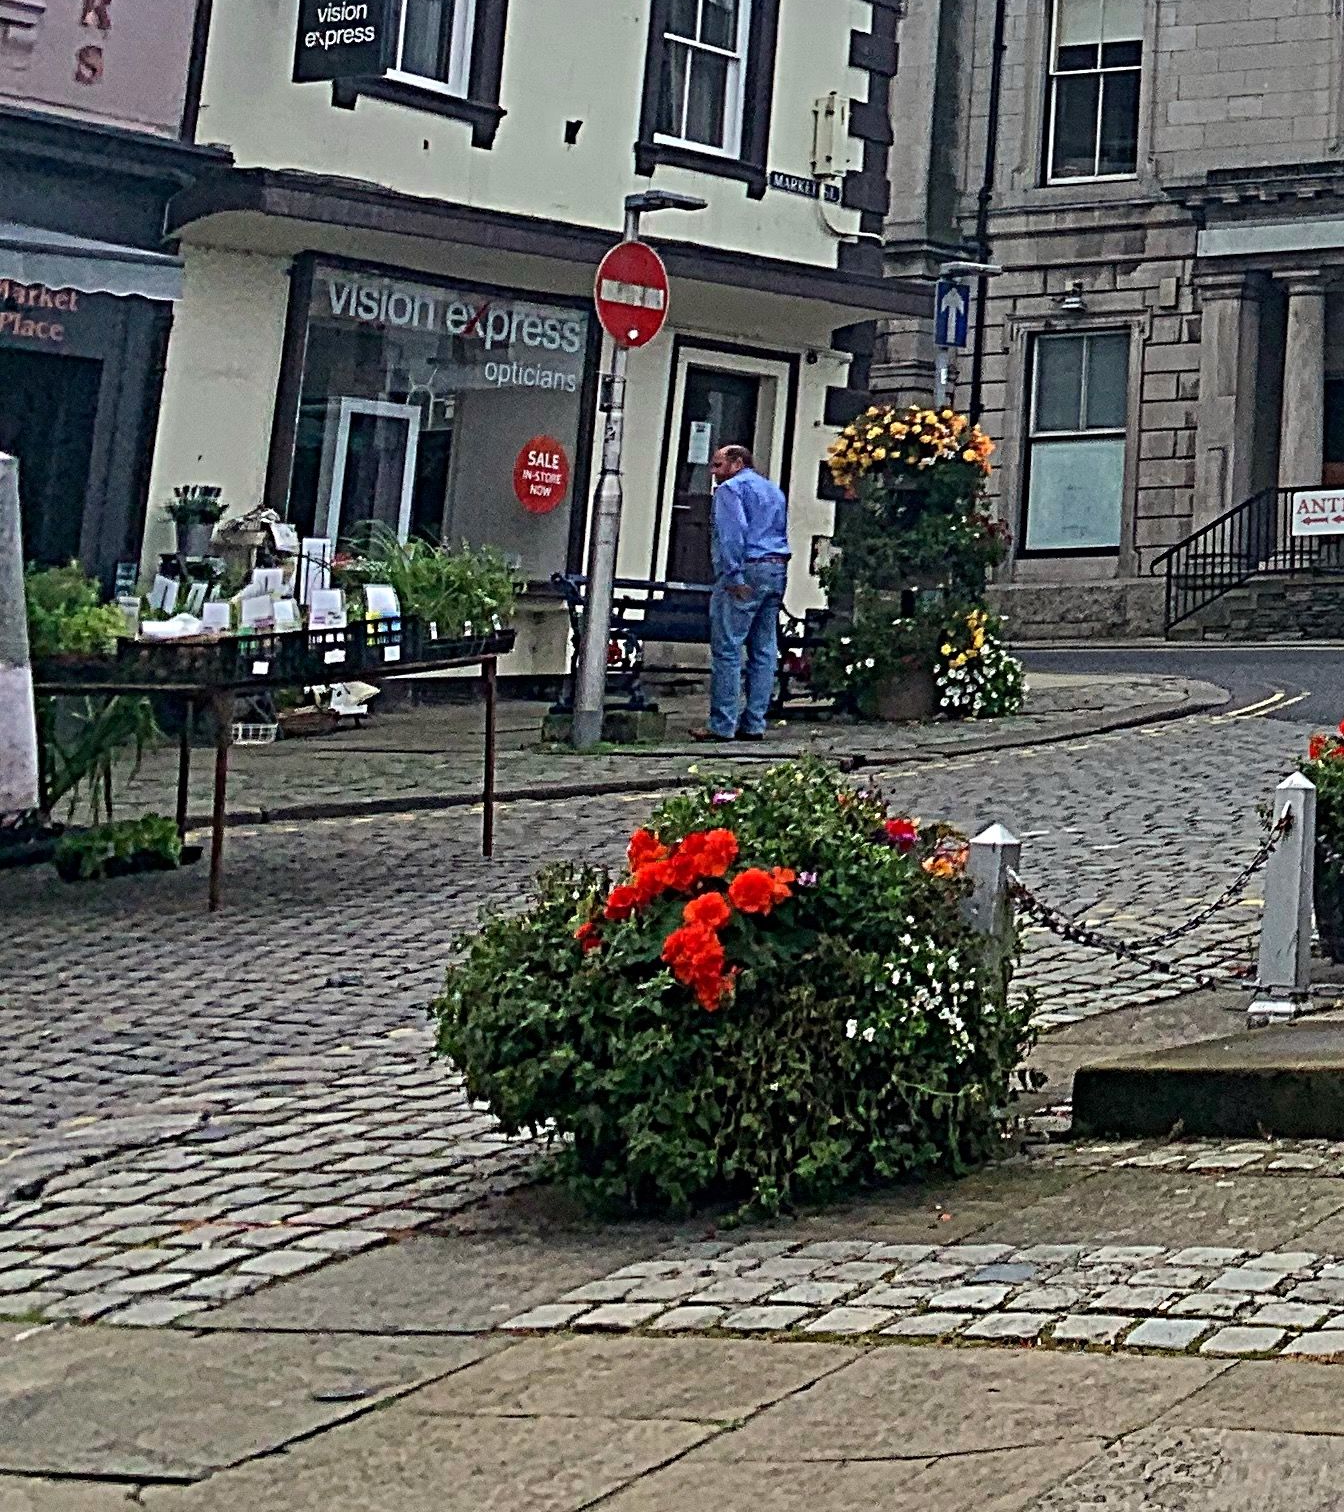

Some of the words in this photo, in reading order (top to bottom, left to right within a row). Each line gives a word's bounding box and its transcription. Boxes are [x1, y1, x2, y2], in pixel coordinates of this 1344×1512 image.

[317, 1, 368, 23] vision
[305, 26, 375, 50] express
[774, 173, 817, 197] MARKET
[0, 312, 64, 341] Place
[329, 280, 434, 330] vision
[446, 301, 580, 353] express
[485, 361, 576, 392] opticians
[528, 450, 559, 469] SALE
[522, 469, 562, 484] IN-STORE
[530, 484, 552, 496] NOW
